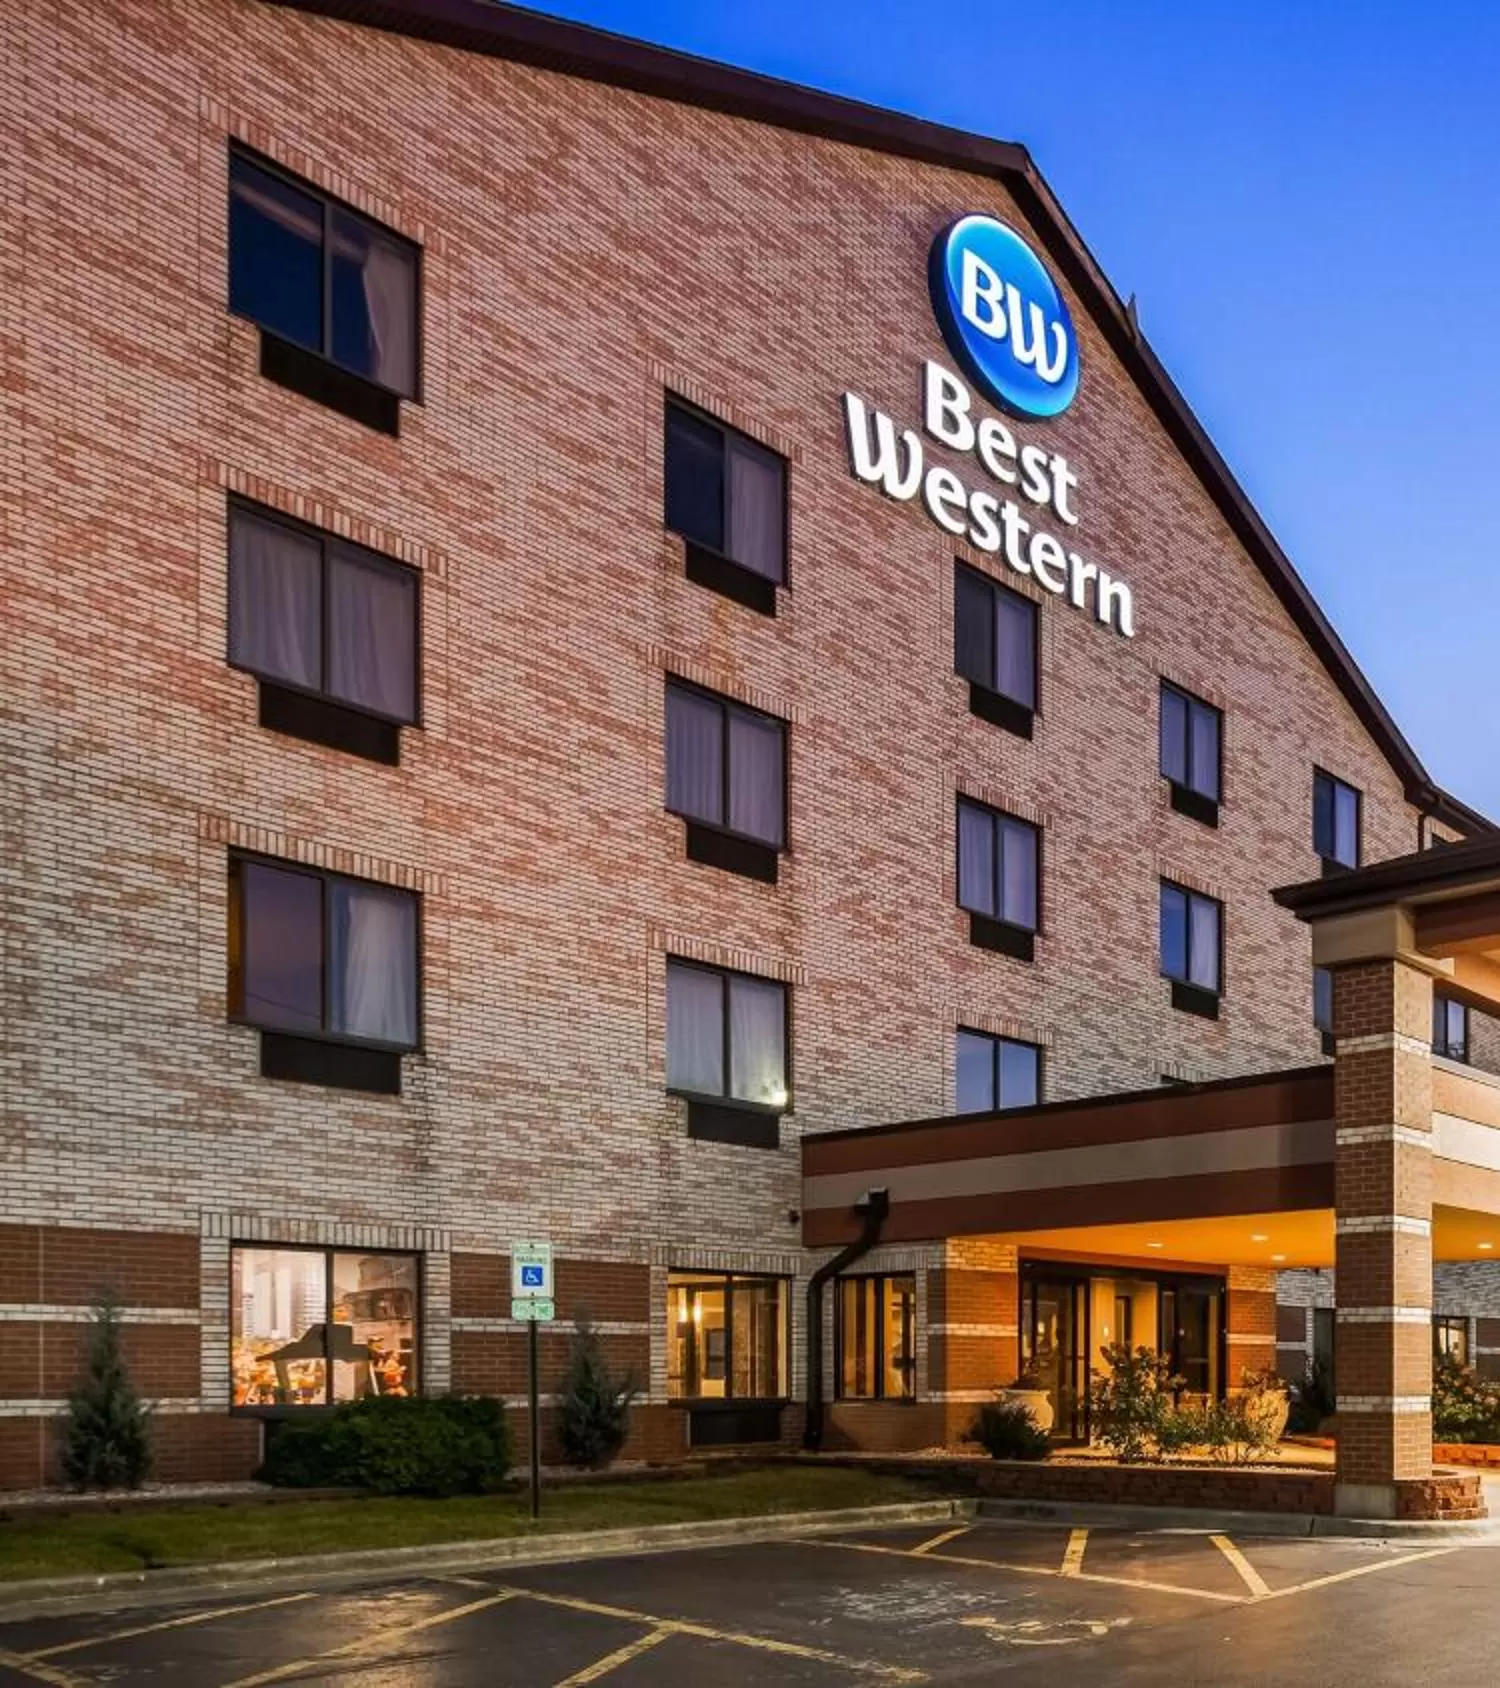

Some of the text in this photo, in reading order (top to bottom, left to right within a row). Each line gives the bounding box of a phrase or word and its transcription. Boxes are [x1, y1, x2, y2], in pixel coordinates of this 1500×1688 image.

[962, 247, 1067, 384] BW
[845, 391, 1134, 638] Western
[926, 359, 1078, 526] Best
